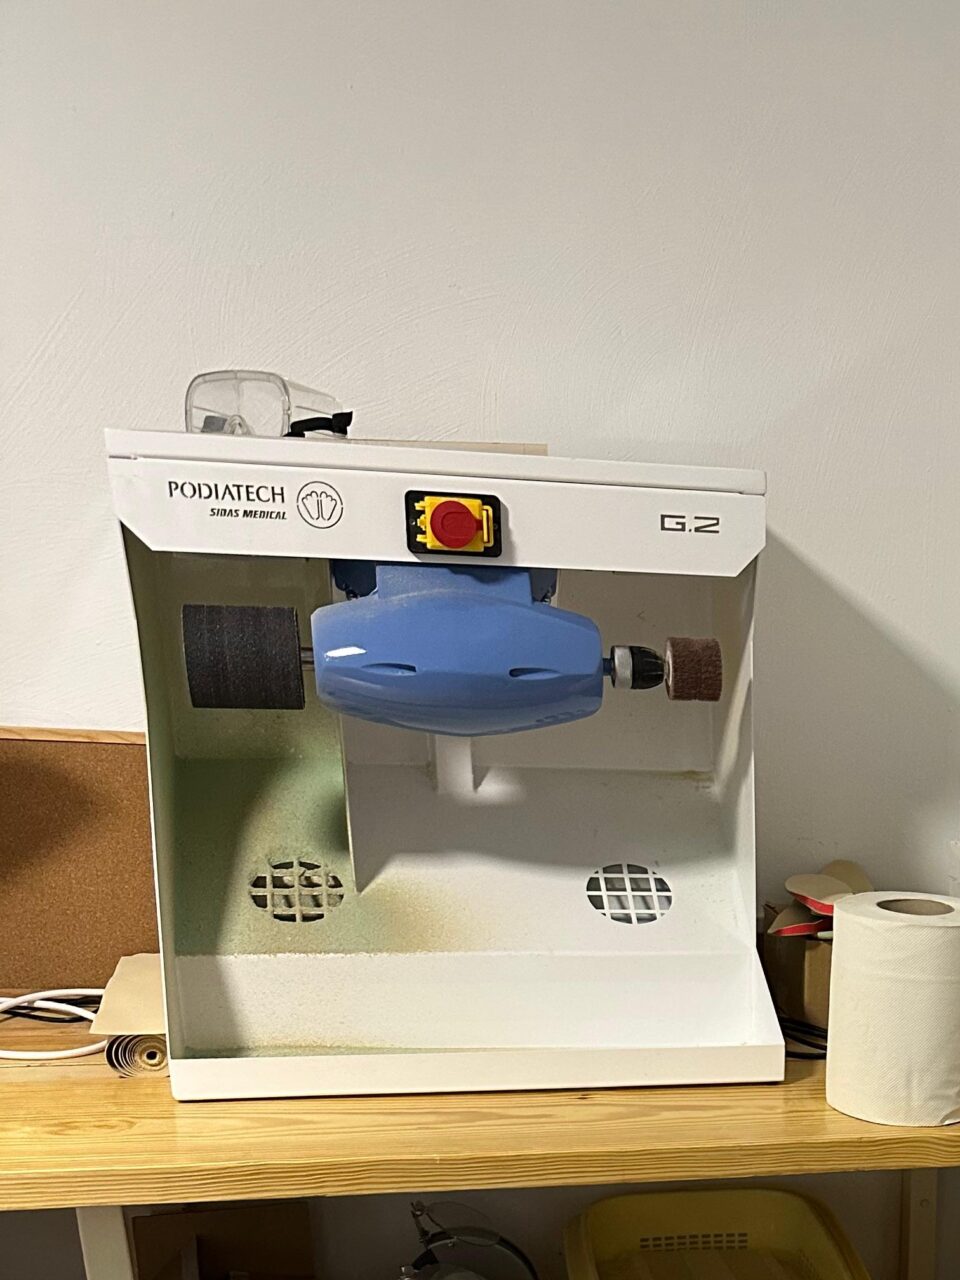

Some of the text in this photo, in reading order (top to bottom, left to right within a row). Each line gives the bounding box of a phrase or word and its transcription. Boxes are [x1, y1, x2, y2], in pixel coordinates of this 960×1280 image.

[168, 480, 285, 504] PODIATECH
[209, 507, 288, 520] SIDAS MEDICAL
[660, 514, 720, 534] G.2
